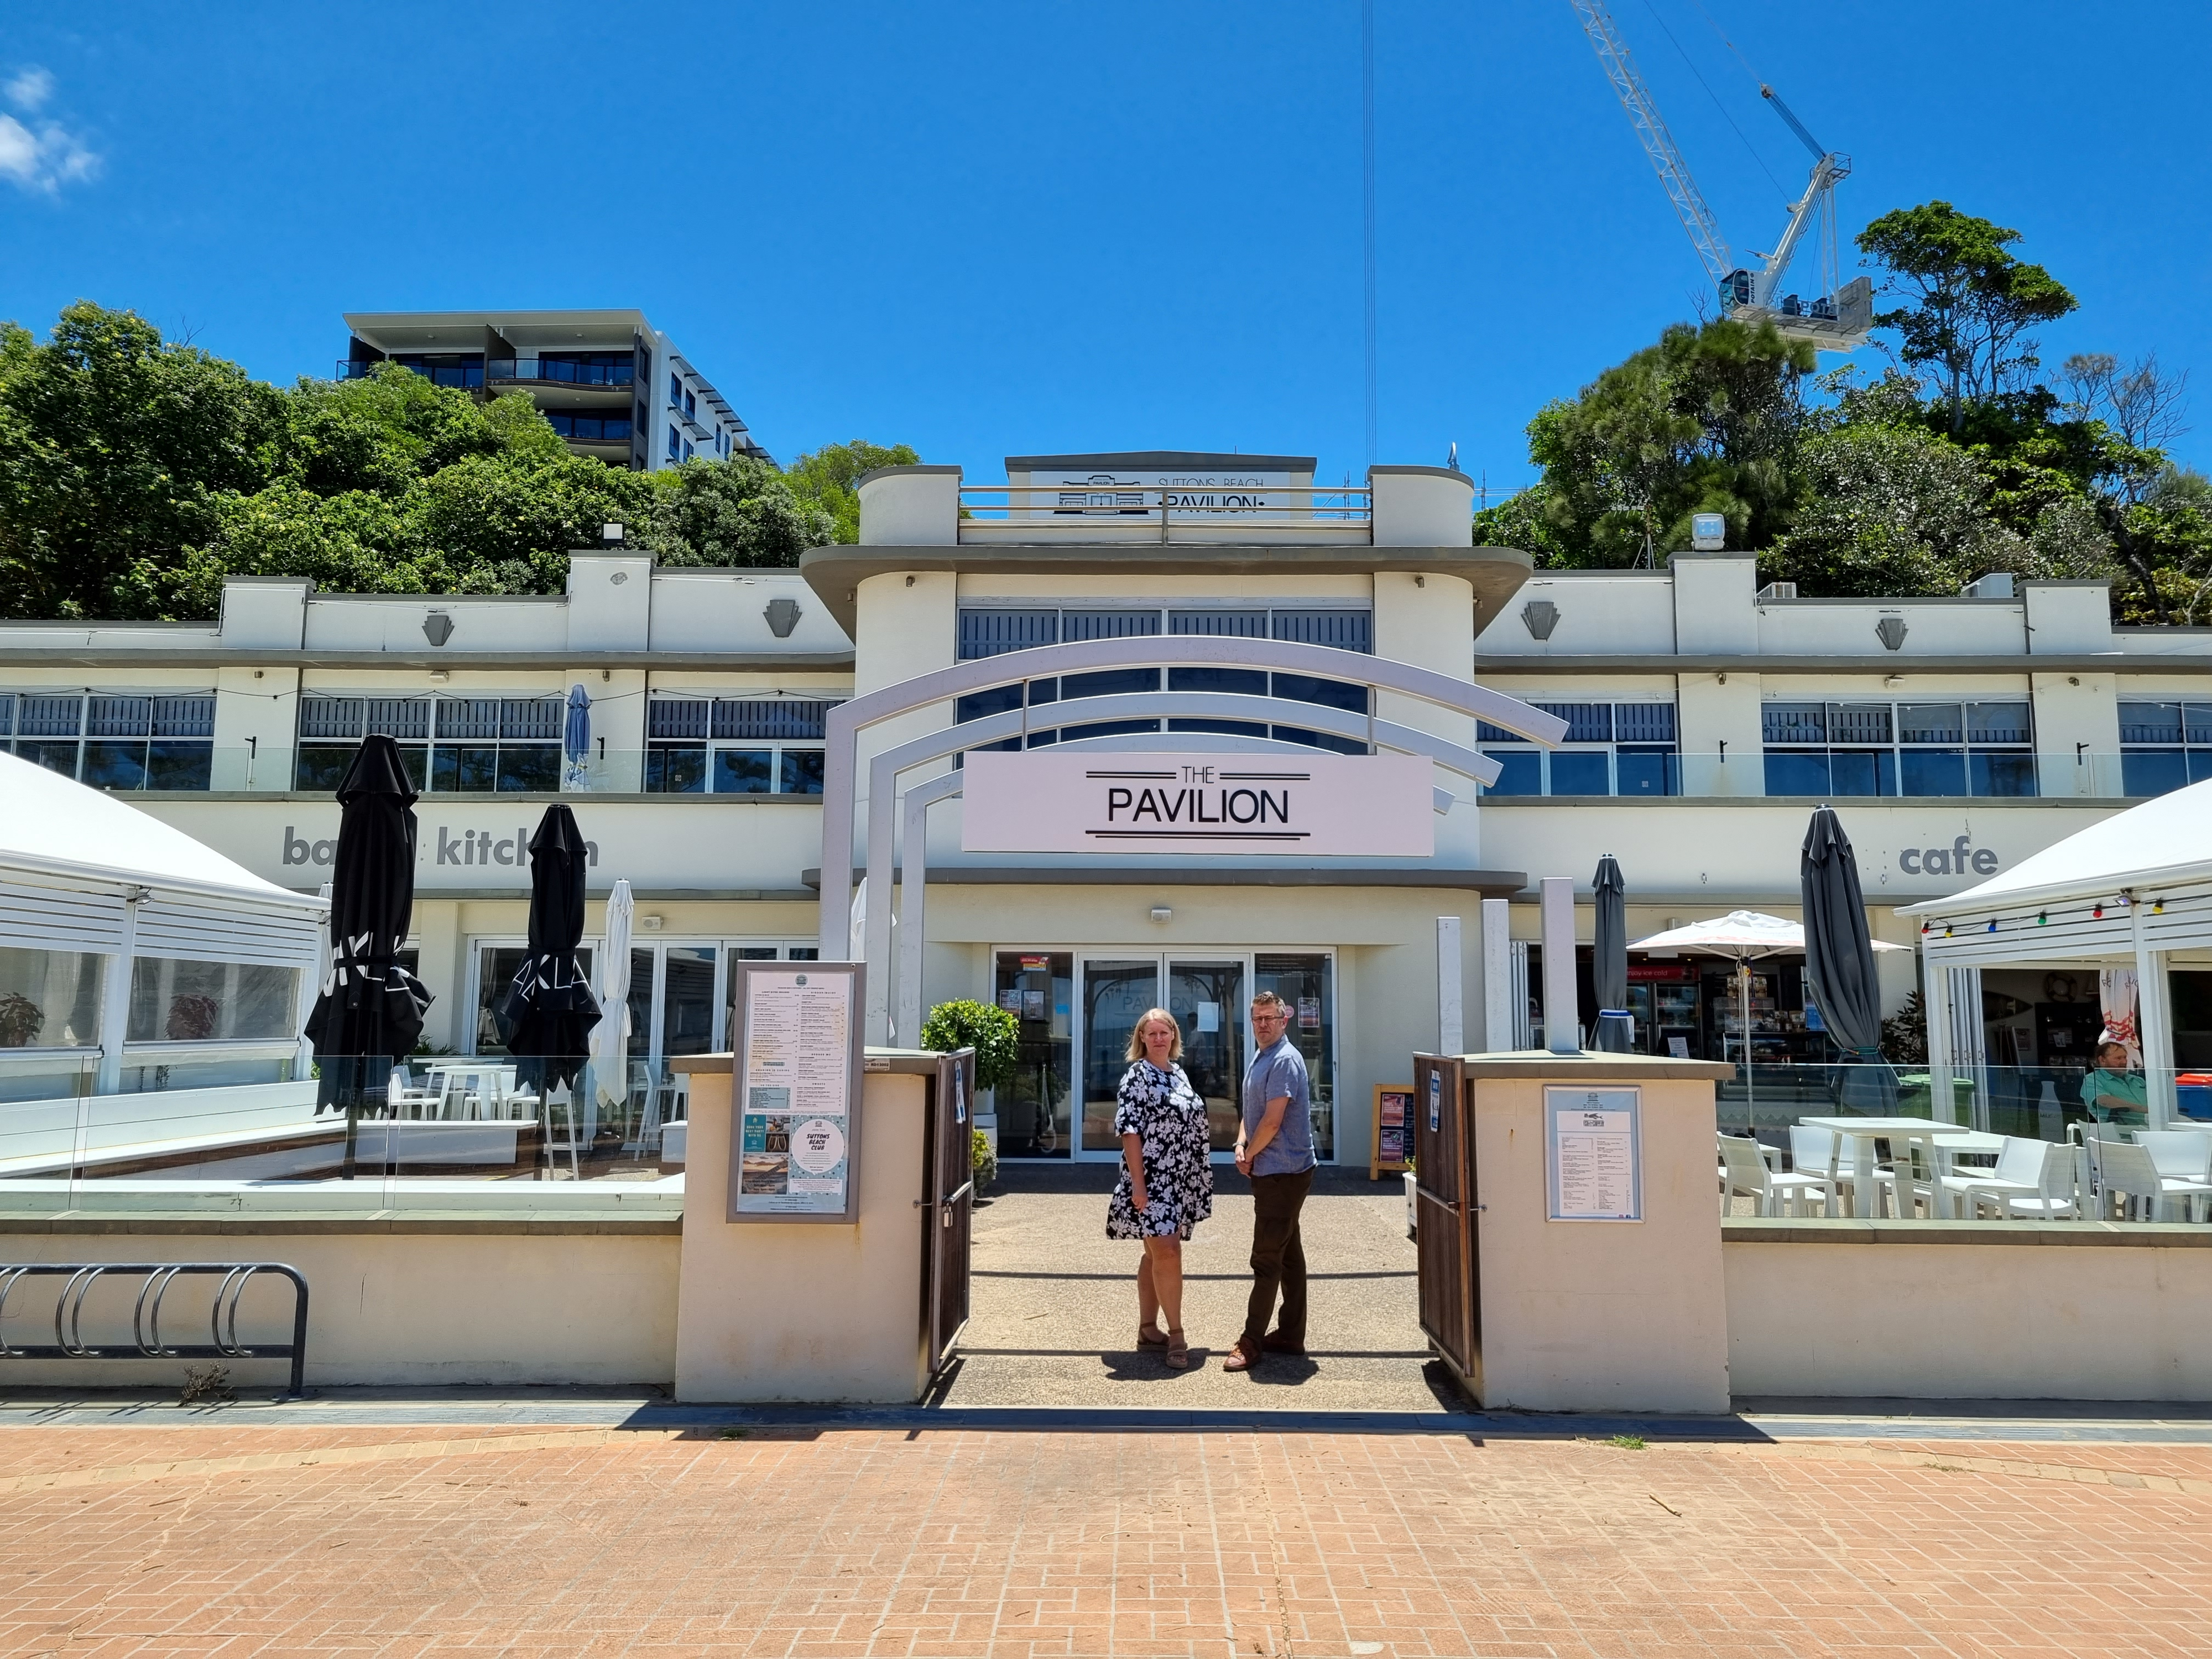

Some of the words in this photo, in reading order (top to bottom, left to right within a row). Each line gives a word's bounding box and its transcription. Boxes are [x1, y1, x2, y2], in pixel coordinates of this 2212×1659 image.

[1167, 495, 1256, 513] PAVILION
[1181, 766, 1215, 784] THE
[1108, 788, 1288, 823] PAVILION
[283, 826, 336, 865] ba
[436, 826, 598, 867] kitchn
[1899, 835, 1998, 875] cafe
[1123, 997, 1193, 1011] PAVON
